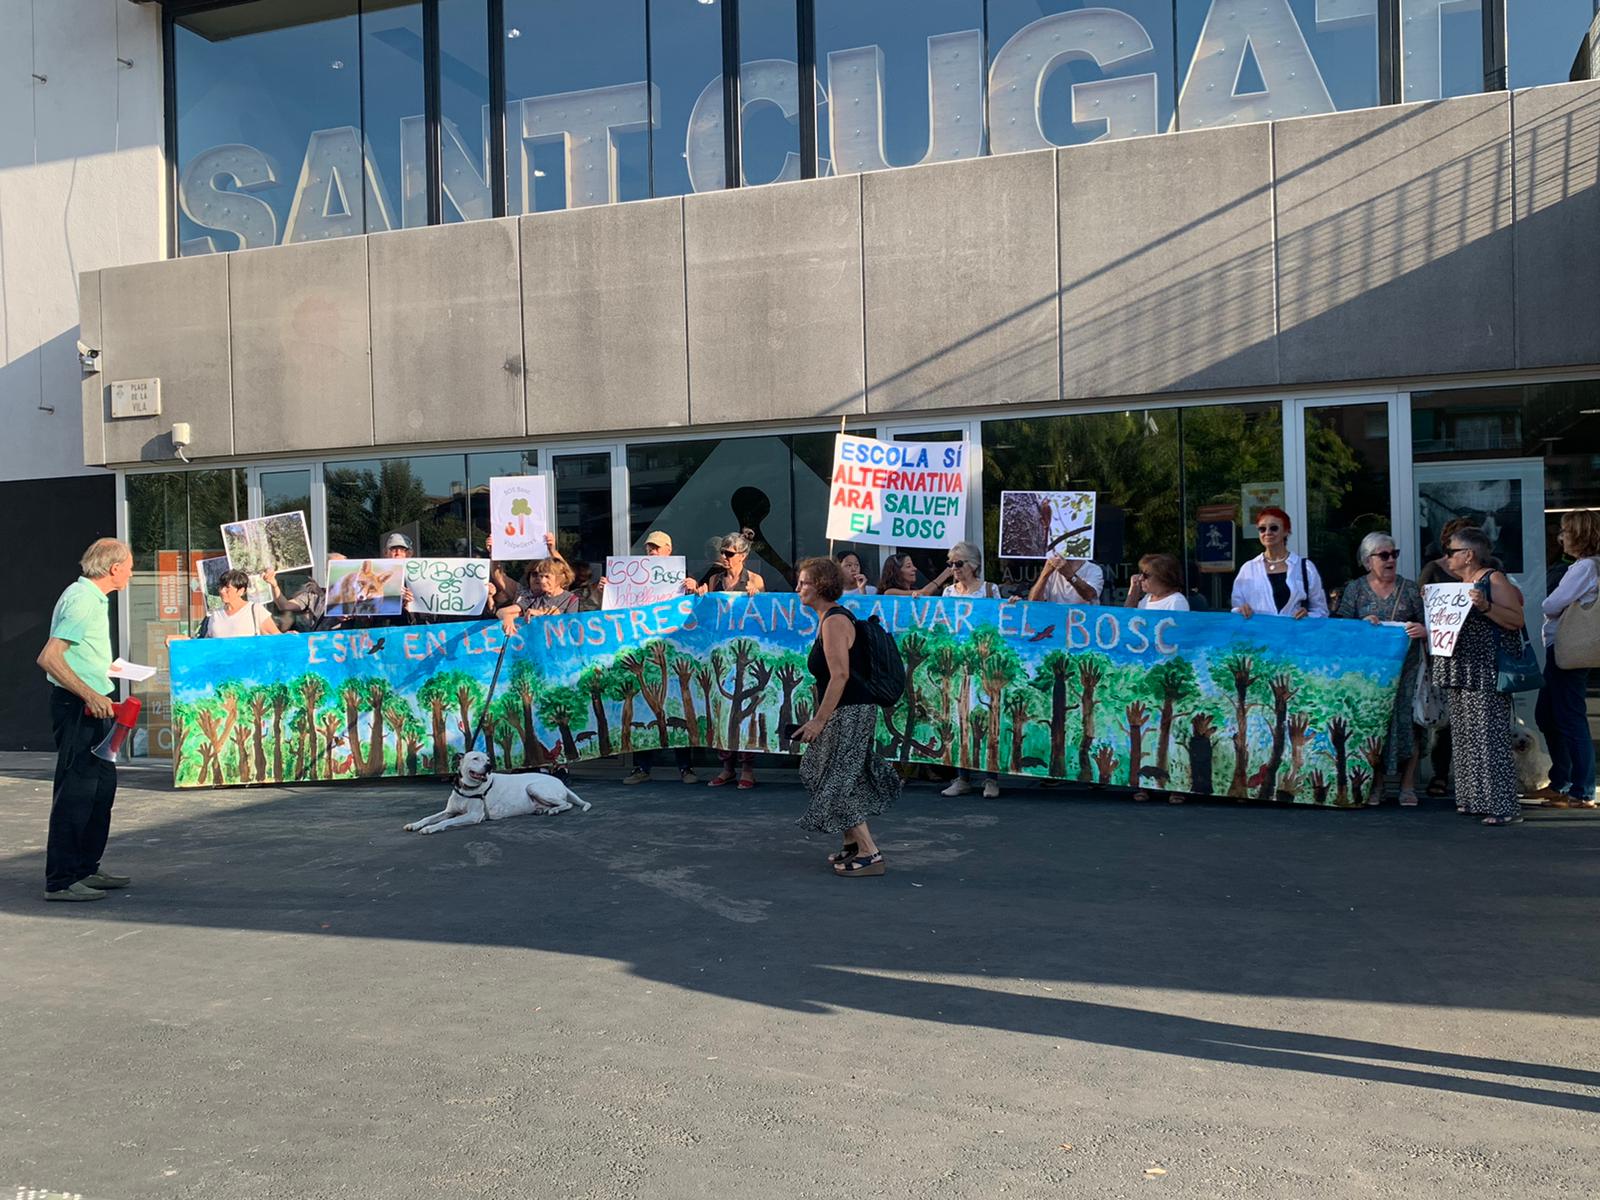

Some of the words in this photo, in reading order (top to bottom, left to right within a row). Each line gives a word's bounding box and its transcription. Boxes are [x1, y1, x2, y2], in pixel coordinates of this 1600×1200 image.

[178, 80, 660, 258] SANT
[686, 0, 1484, 192] CUGAT
[841, 442, 929, 468] ESCOLA
[943, 444, 963, 468] SÍ
[833, 464, 963, 493] ALTERNATIVA
[833, 488, 874, 510] ARA
[884, 493, 959, 516] SALVEM
[850, 513, 880, 535] EL
[892, 517, 946, 540] BOSC
[406, 560, 428, 582] El
[429, 561, 487, 582] Bosc
[420, 593, 475, 612] Vida
[1451, 588, 1469, 607] de
[403, 629, 448, 660] EN
[543, 600, 698, 650] NOSTRES
[714, 597, 819, 636] MANS
[998, 602, 1036, 638] EL
[1066, 608, 1178, 655] BOSC
